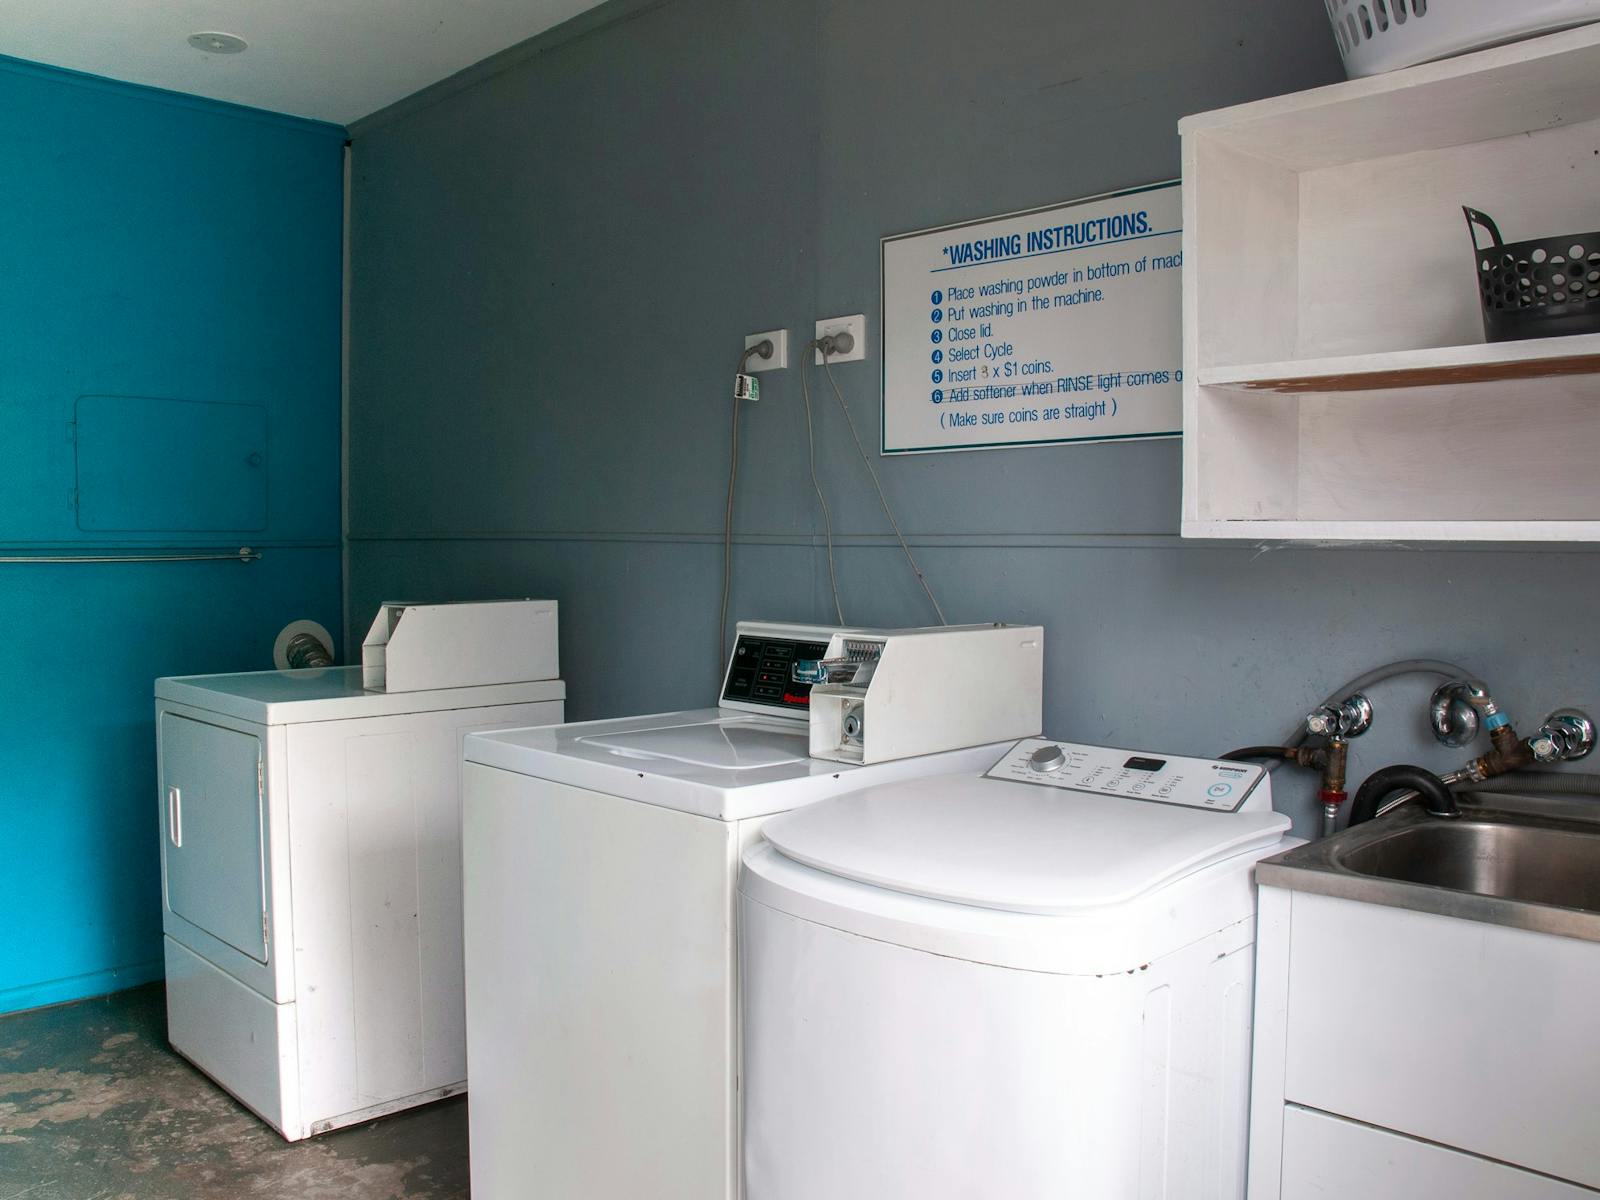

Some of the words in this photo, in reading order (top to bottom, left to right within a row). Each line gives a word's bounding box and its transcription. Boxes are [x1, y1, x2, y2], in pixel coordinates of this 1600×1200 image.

[1027, 211, 1153, 253] INSTRUCTIONS.
[948, 287, 975, 302] Place
[979, 279, 1023, 297] washing
[1028, 271, 1068, 292] powder
[1073, 268, 1083, 283] in
[1087, 262, 1130, 281] bottom
[1135, 256, 1147, 273] of
[948, 306, 965, 321] Put
[970, 301, 1014, 318] washing
[1017, 298, 1027, 313] in
[1032, 295, 1050, 310] the
[1054, 288, 1105, 307] machine.
[948, 327, 976, 342] Close
[979, 323, 994, 338] lid.
[948, 345, 980, 362] Select
[984, 341, 1013, 361] Cycle
[948, 366, 977, 382] Insert
[992, 367, 1000, 378] x
[1021, 359, 1054, 375] coins.
[949, 388, 969, 403] Add
[973, 385, 1016, 401] softener
[1021, 381, 1053, 396] when
[1057, 375, 1093, 393] RINSE
[1097, 372, 1121, 392] light
[1126, 370, 1169, 387] comes
[949, 412, 977, 428] Make
[981, 412, 1004, 425] sure
[1008, 407, 1038, 423] coins
[1043, 407, 1060, 421] are
[1064, 400, 1106, 421] straight
